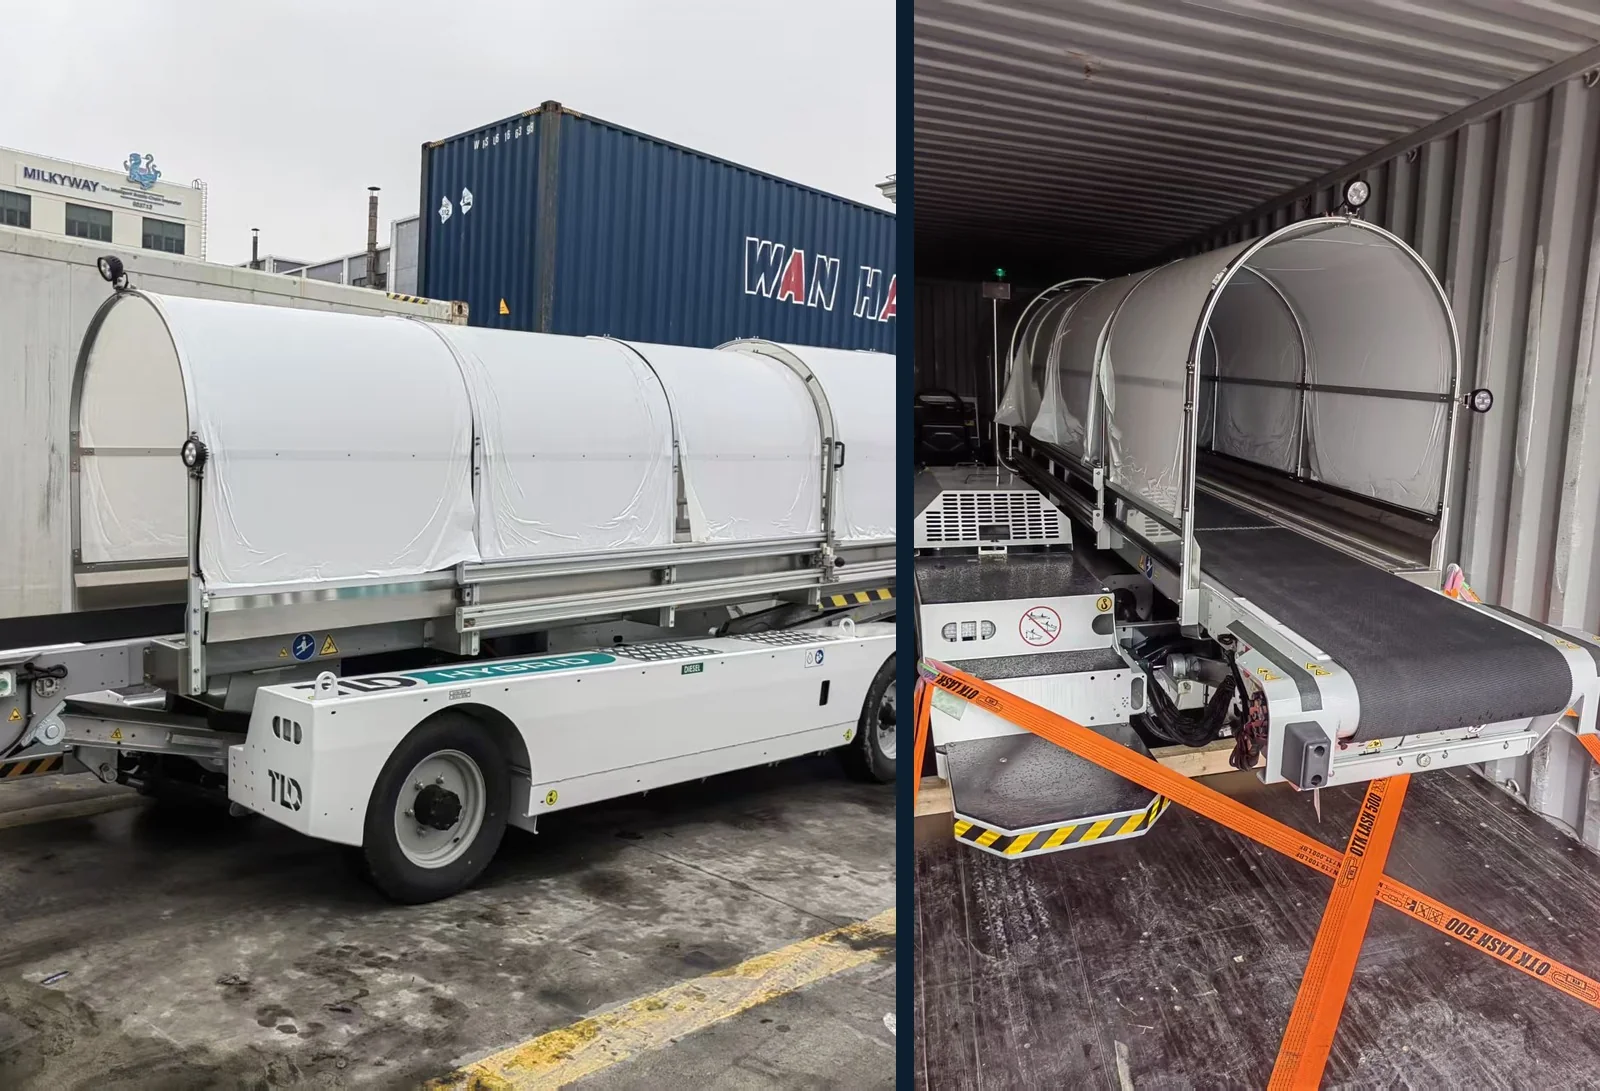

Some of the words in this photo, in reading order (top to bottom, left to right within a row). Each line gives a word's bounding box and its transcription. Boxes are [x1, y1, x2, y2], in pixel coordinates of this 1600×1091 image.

[24, 167, 99, 193] MILKYWAY
[745, 236, 840, 311] WAN
[436, 656, 591, 679] HYBRID
[683, 664, 701, 674] DIESEL
[936, 675, 962, 691] LASH
[955, 685, 979, 699] OTK
[268, 769, 303, 812] TLD
[1365, 792, 1382, 813] 500
[1357, 811, 1376, 838] LASH
[1350, 834, 1369, 857] OTK
[1445, 917, 1479, 941] 500
[1476, 932, 1519, 960] LASH
[1515, 951, 1551, 976] OTK
